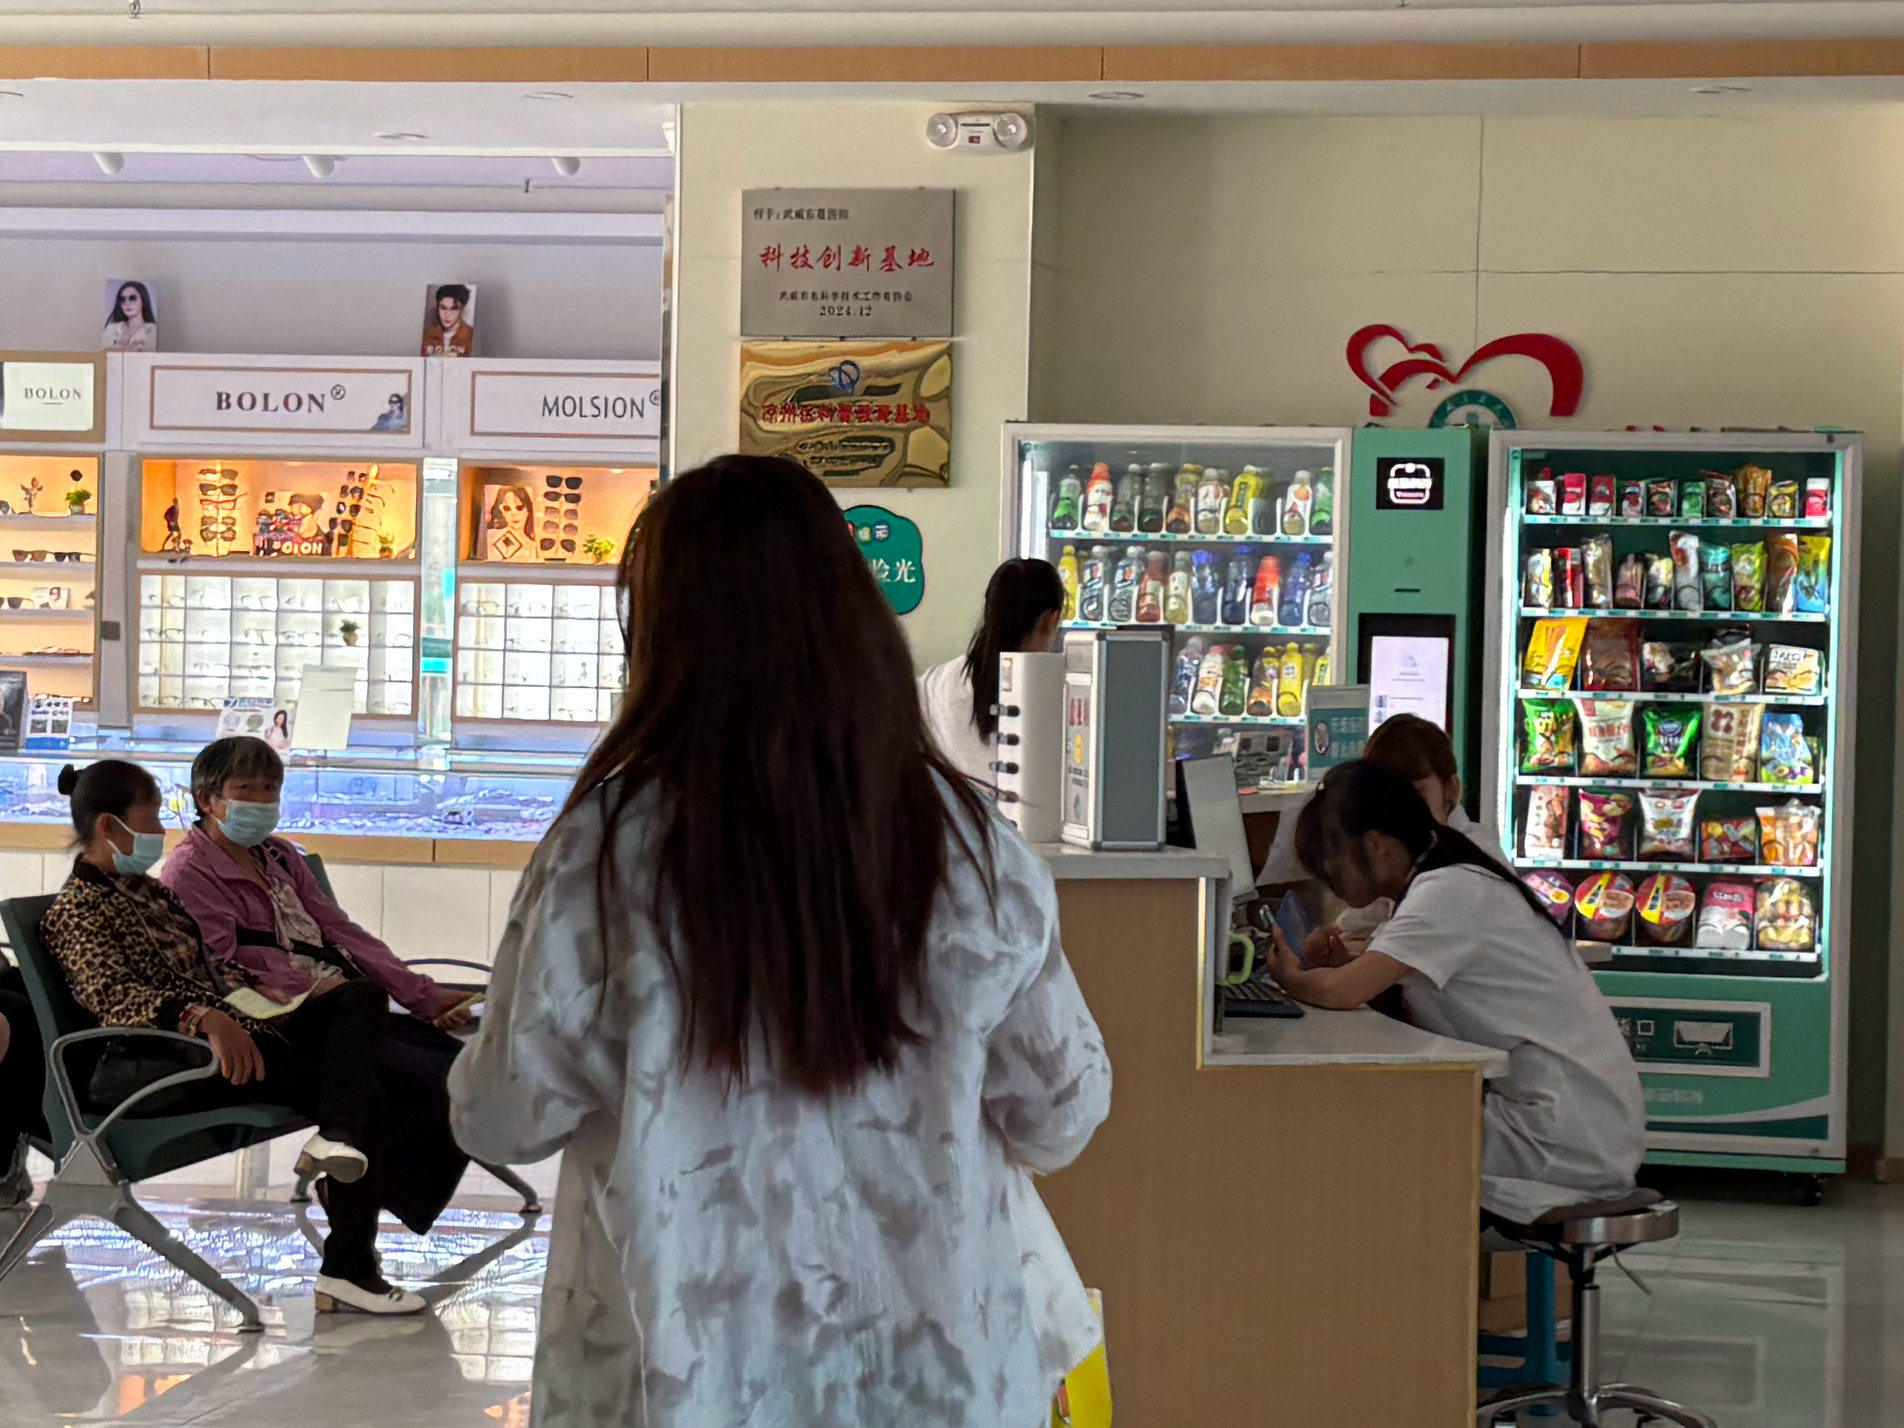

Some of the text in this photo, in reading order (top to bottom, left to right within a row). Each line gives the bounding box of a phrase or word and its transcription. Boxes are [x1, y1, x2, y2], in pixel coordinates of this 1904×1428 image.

[759, 243, 935, 273] 科技创新基地
[24, 387, 82, 400] BOLON
[215, 391, 326, 413] BOLON
[541, 395, 645, 419] MOLSION
